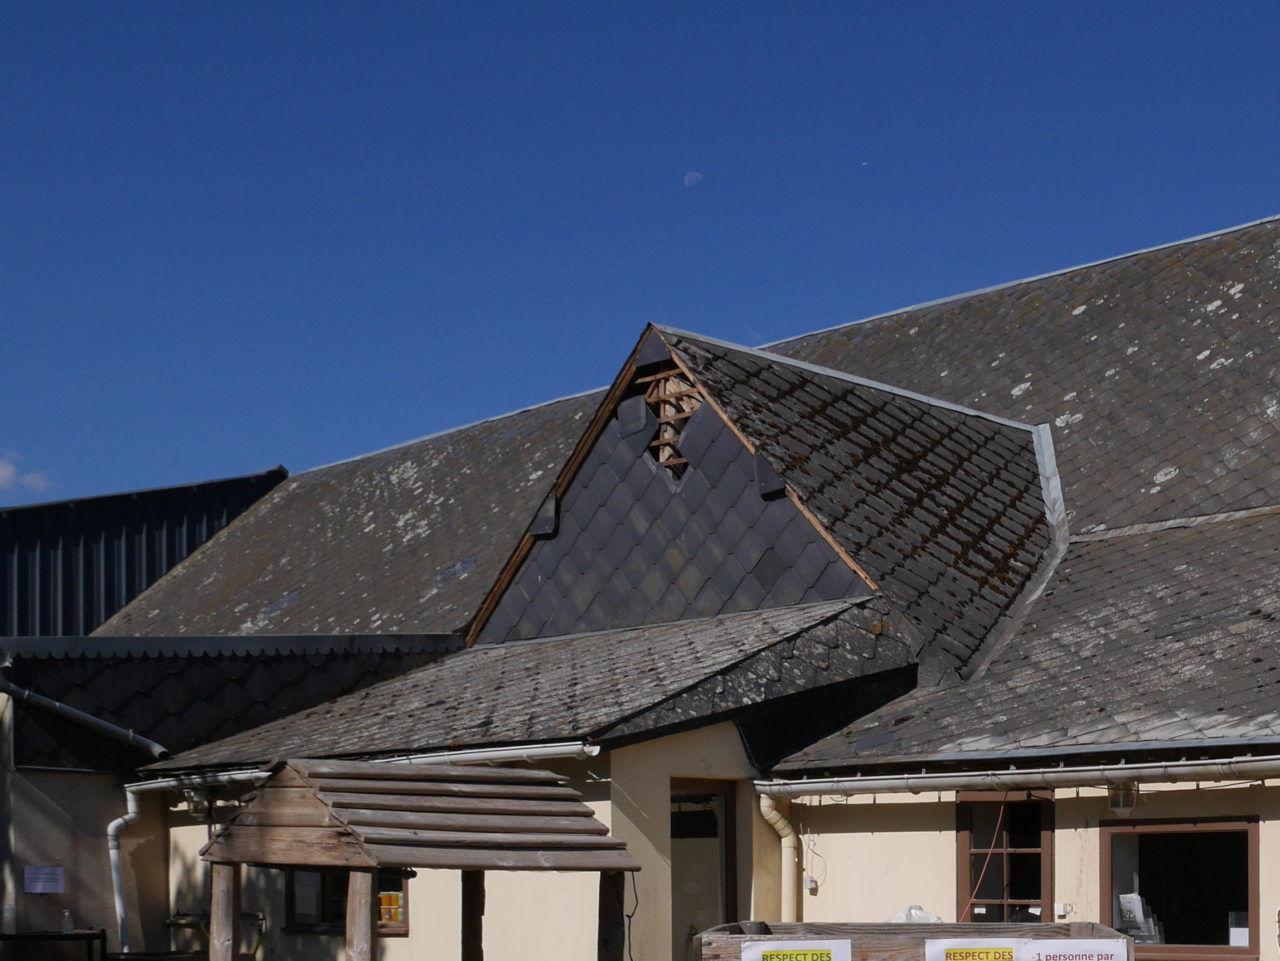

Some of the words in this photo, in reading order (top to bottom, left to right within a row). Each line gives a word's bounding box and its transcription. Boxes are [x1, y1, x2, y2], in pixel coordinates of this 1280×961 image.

[811, 952, 832, 961] DES
[945, 952, 990, 961] RESPECT
[994, 951, 1013, 960] DES
[1097, 953, 1114, 961] par
